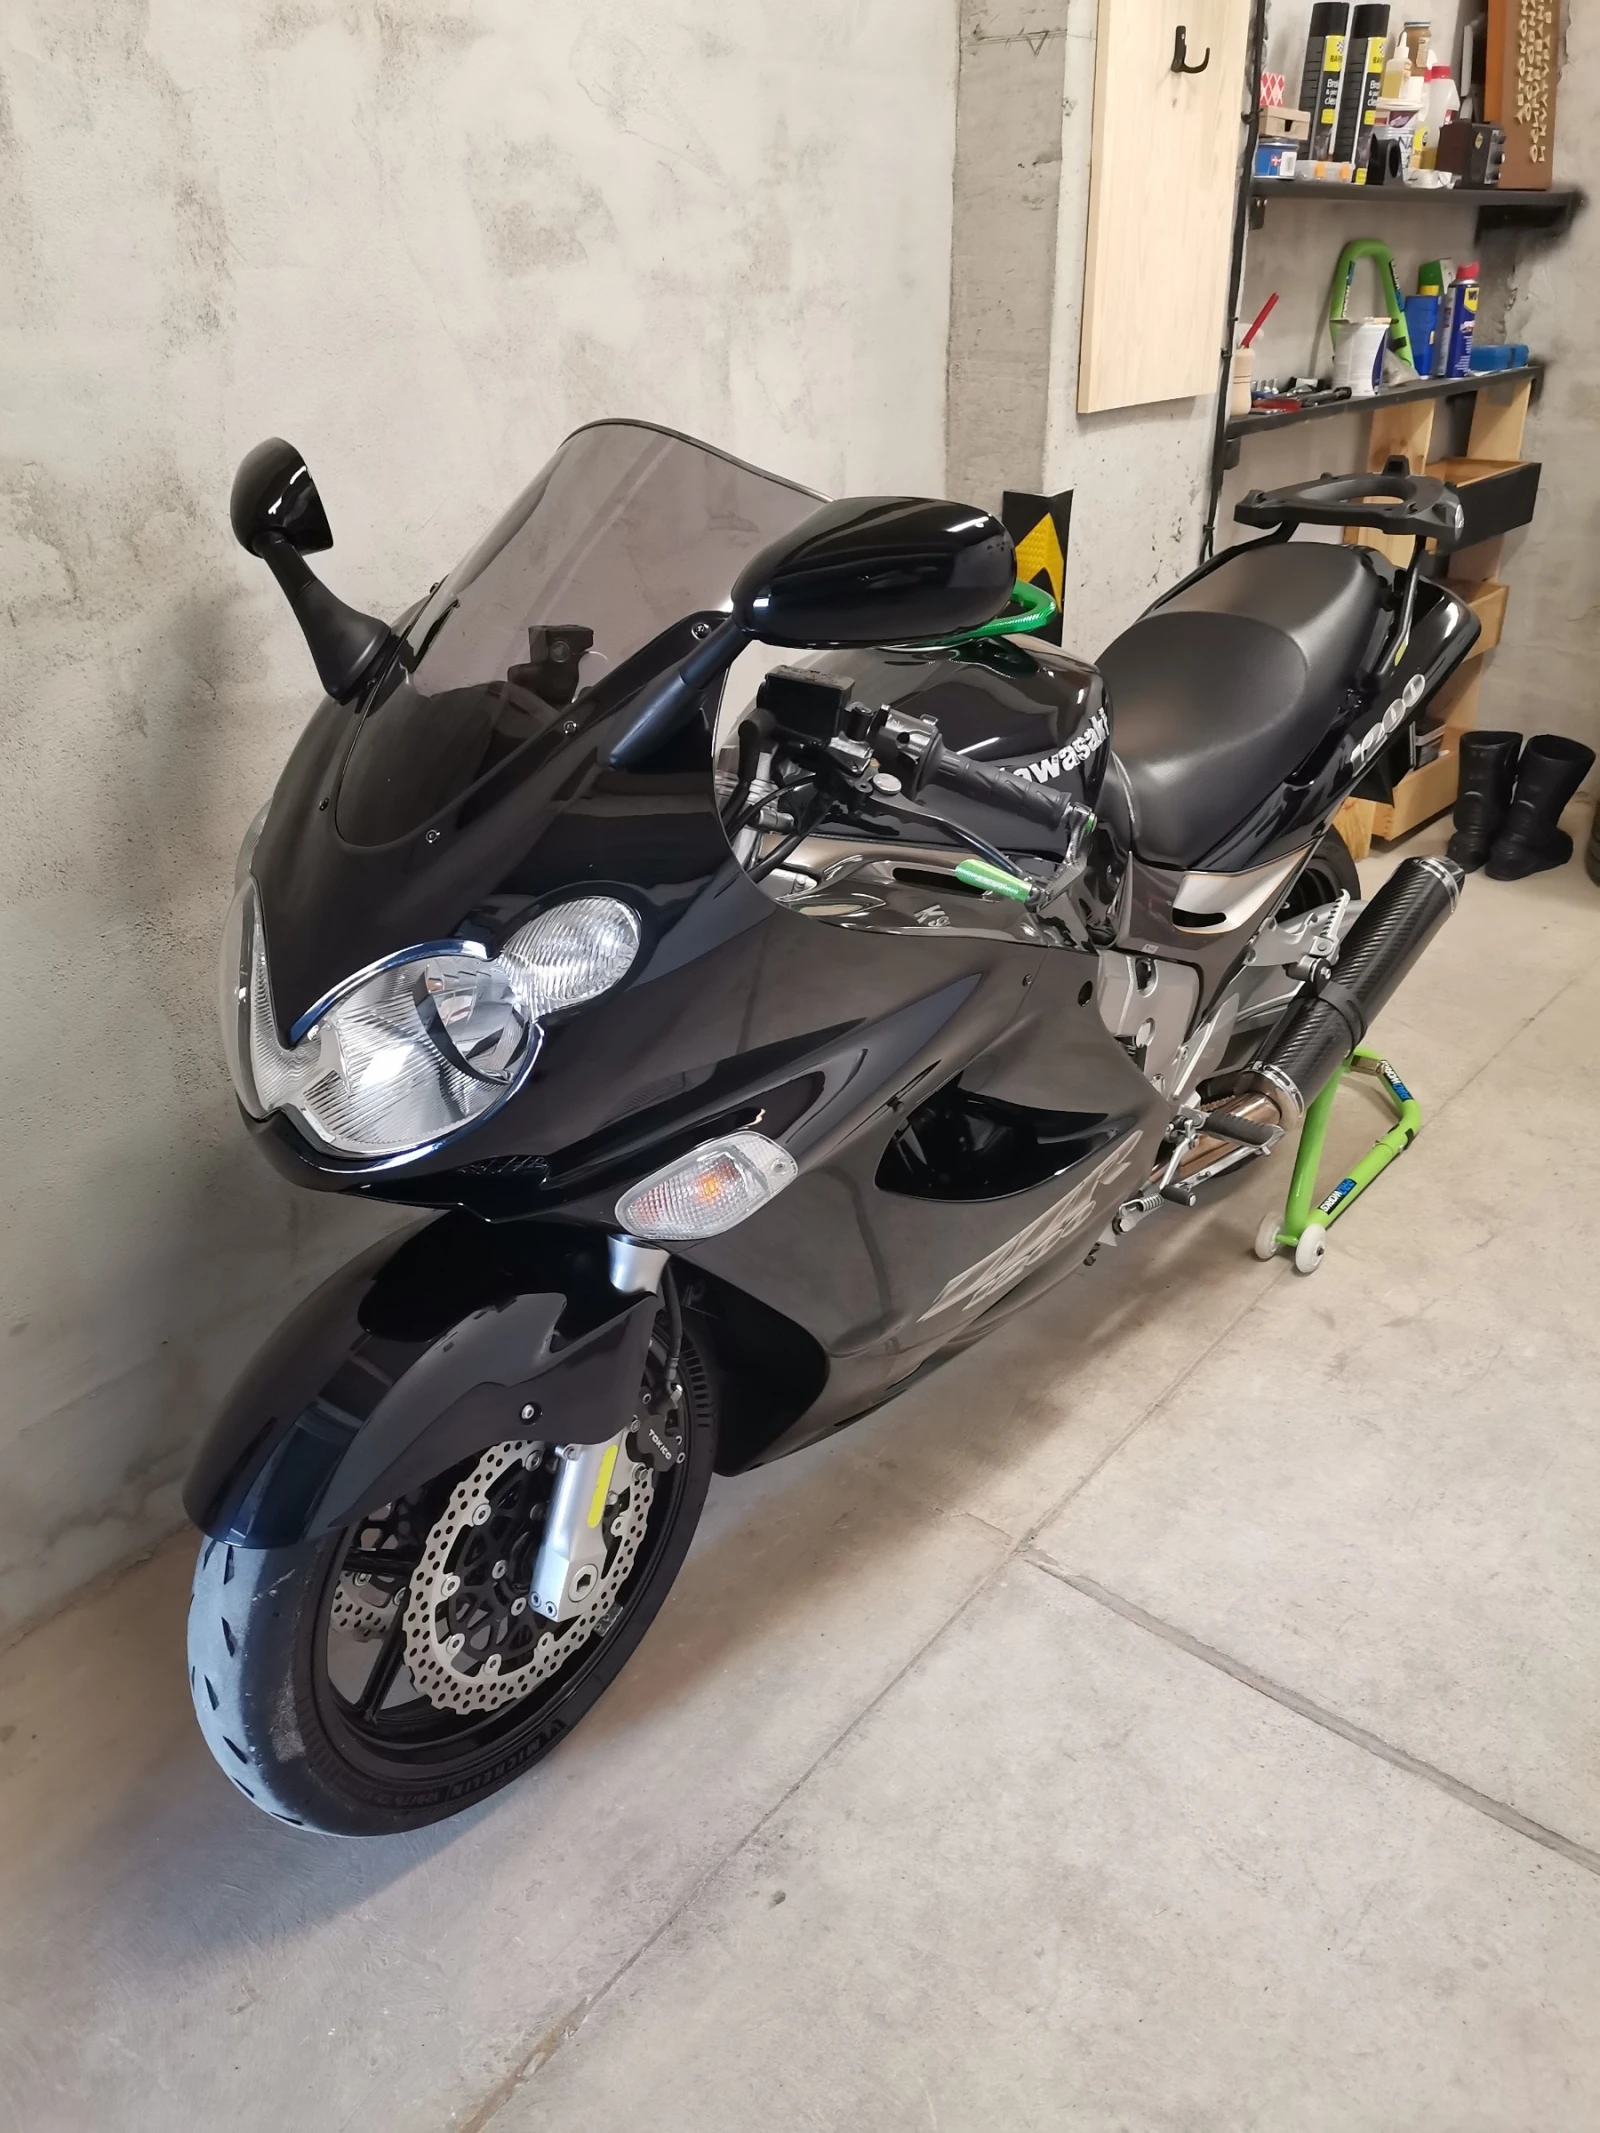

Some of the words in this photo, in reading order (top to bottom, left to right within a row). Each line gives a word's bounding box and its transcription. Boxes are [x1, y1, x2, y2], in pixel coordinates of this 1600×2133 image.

[999, 707, 1110, 784] awasaki
[1319, 1179, 1356, 1213] PROWORKS
[649, 1429, 672, 1460] TOKICO
[451, 1737, 542, 1799] MICHELIN
